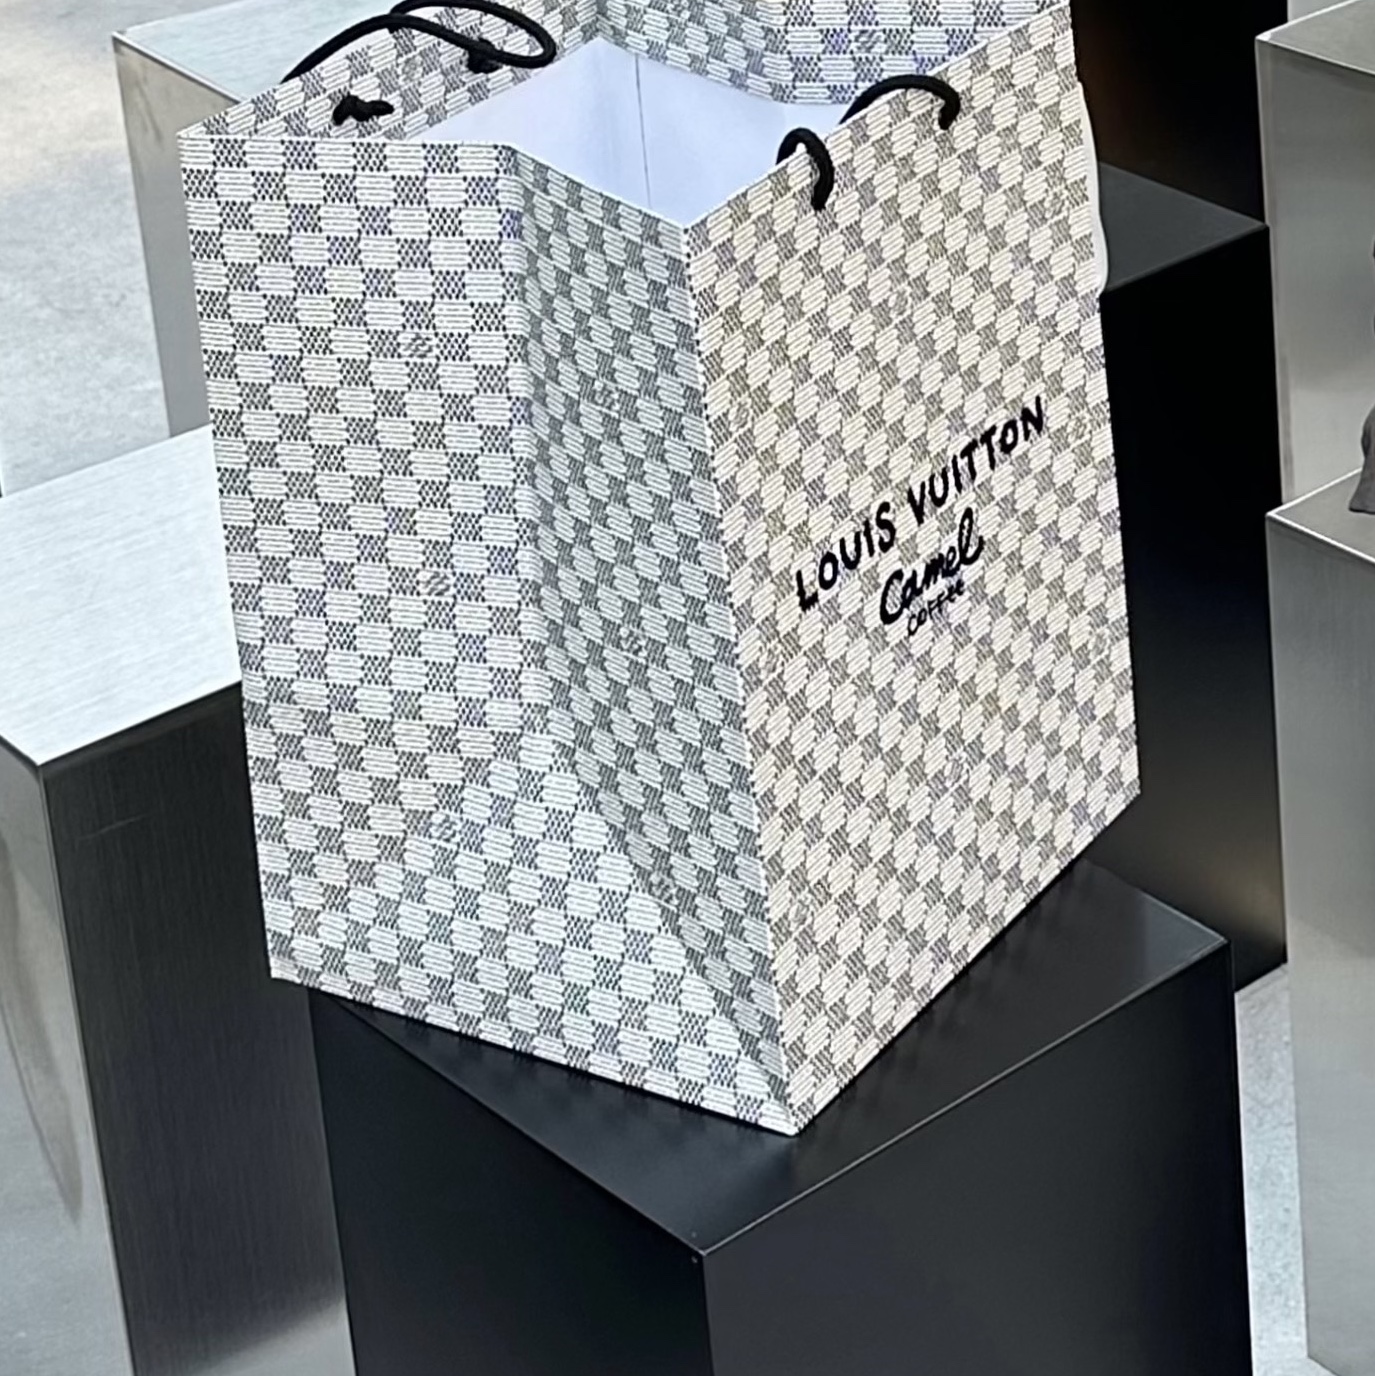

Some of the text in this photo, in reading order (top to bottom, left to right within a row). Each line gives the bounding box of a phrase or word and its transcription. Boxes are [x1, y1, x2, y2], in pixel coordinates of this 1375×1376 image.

[796, 395, 1044, 612] LOUIS VUITTON
[879, 507, 984, 624] Camel
